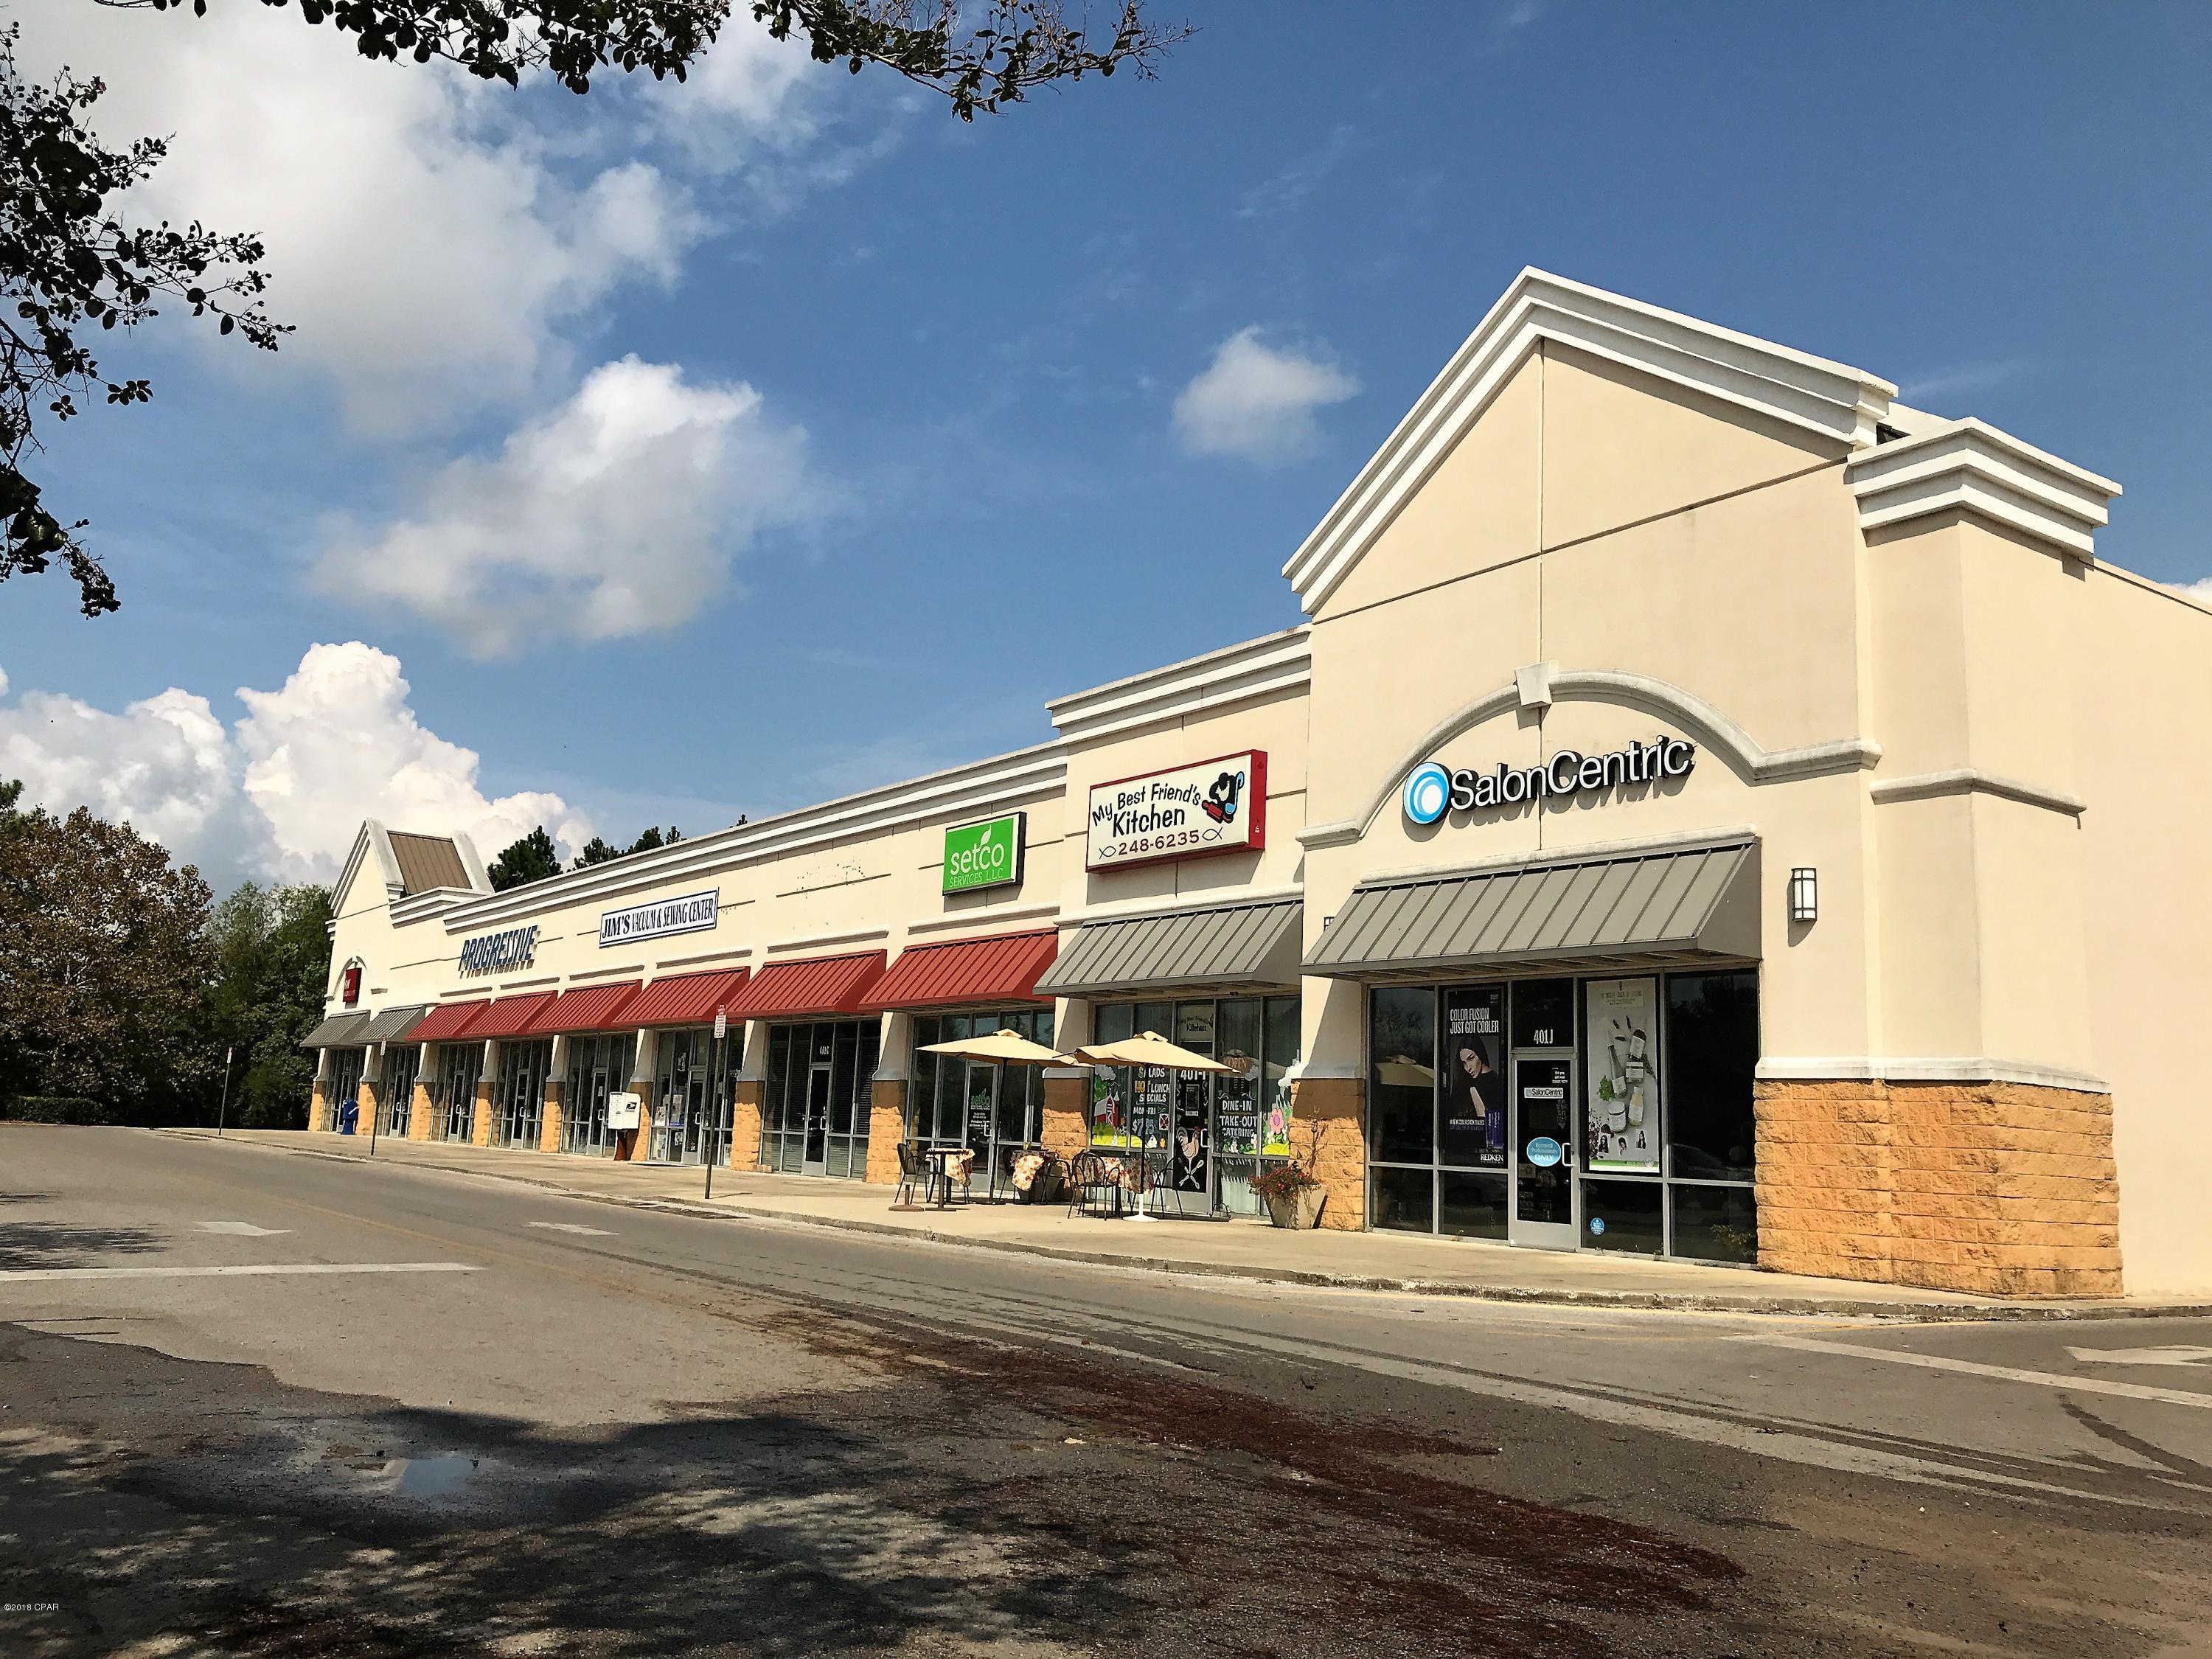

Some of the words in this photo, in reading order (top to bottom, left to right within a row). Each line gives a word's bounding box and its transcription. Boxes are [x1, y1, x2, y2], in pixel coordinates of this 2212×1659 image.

[1450, 735, 1695, 811] SalonCentric
[1091, 803, 1112, 827] My
[1117, 786, 1146, 810] Best
[1150, 782, 1201, 806] Friend's
[1113, 803, 1185, 838] Kitchen
[1118, 830, 1200, 856] 248-6235
[950, 841, 1004, 876] setco
[949, 872, 983, 888] SERVICES
[602, 914, 630, 939] JIM'S
[632, 909, 656, 933] VACUUM
[656, 908, 662, 928] &
[663, 902, 688, 928] SEWING
[689, 897, 714, 922] CENTER
[457, 925, 538, 972] PROGRESSIVE
[1450, 1009, 1468, 1021] COLOR
[1469, 1007, 1489, 1020] FUSION
[1450, 1020, 1464, 1034] JUST
[1464, 1020, 1476, 1034] GOT
[1477, 1020, 1500, 1033] COOLER
[1228, 1057, 1247, 1068] OPEN
[1531, 1088, 1563, 1096] SalonCentric
[1222, 1099, 1252, 1111] DINE-IN
[1219, 1115, 1258, 1127] TAKE-OUT
[1480, 1153, 1504, 1162] REDKEN
[1534, 1153, 1555, 1161] ONLY
